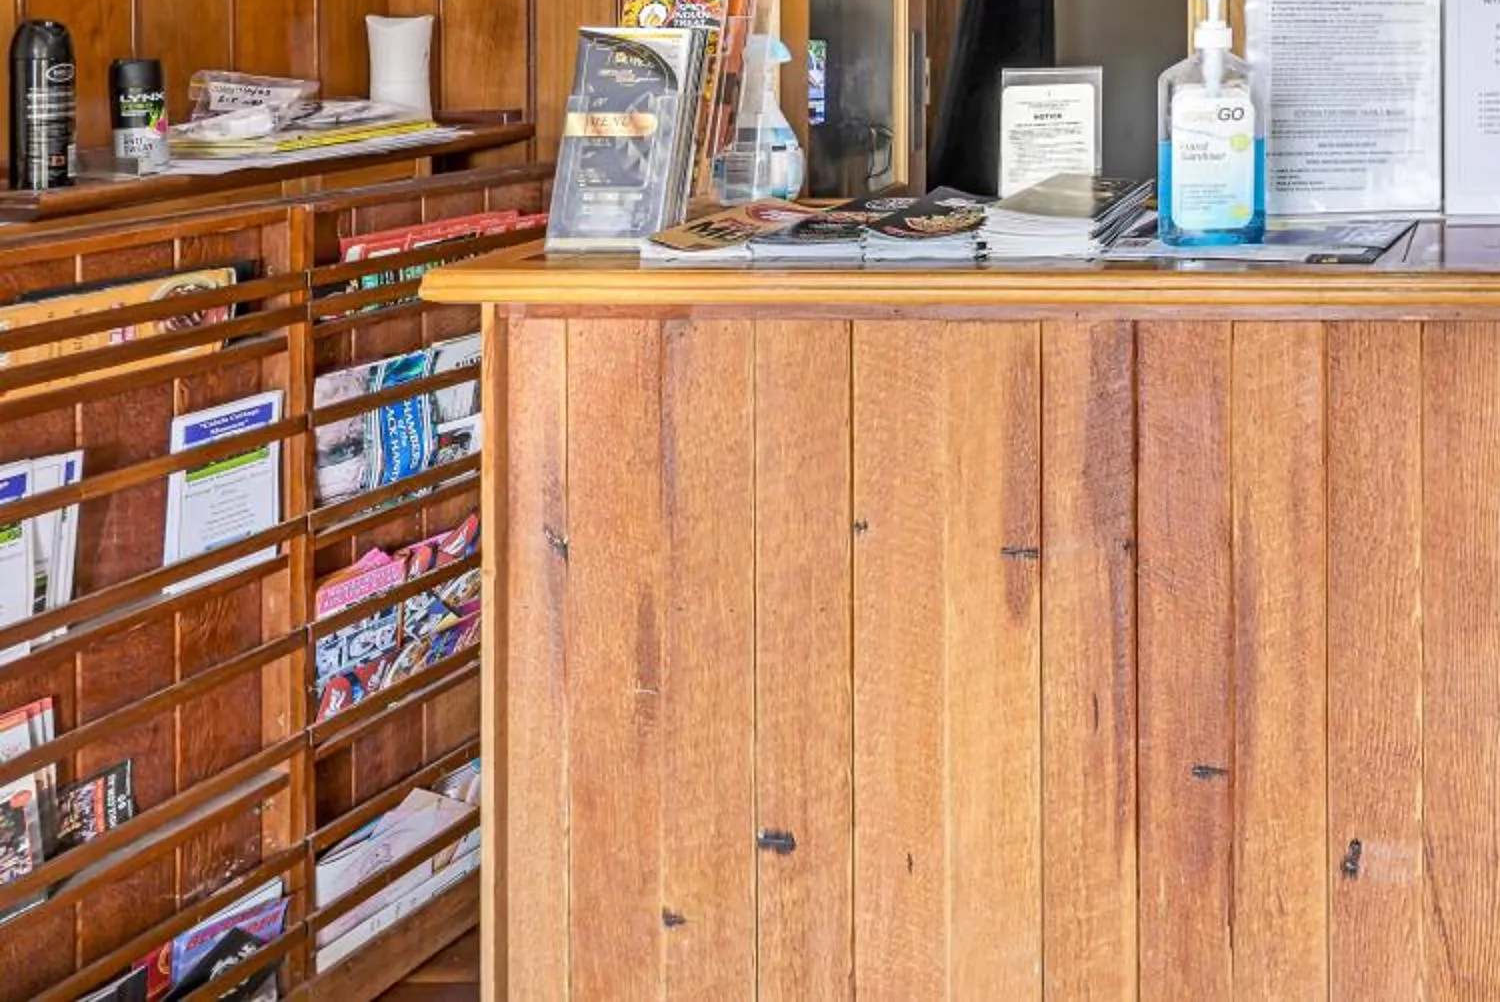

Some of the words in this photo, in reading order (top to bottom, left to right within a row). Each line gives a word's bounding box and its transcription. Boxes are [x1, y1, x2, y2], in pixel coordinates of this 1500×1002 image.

[120, 91, 166, 103] LYNX
[1217, 107, 1246, 121] GO
[404, 400, 421, 469] HAMBERS
